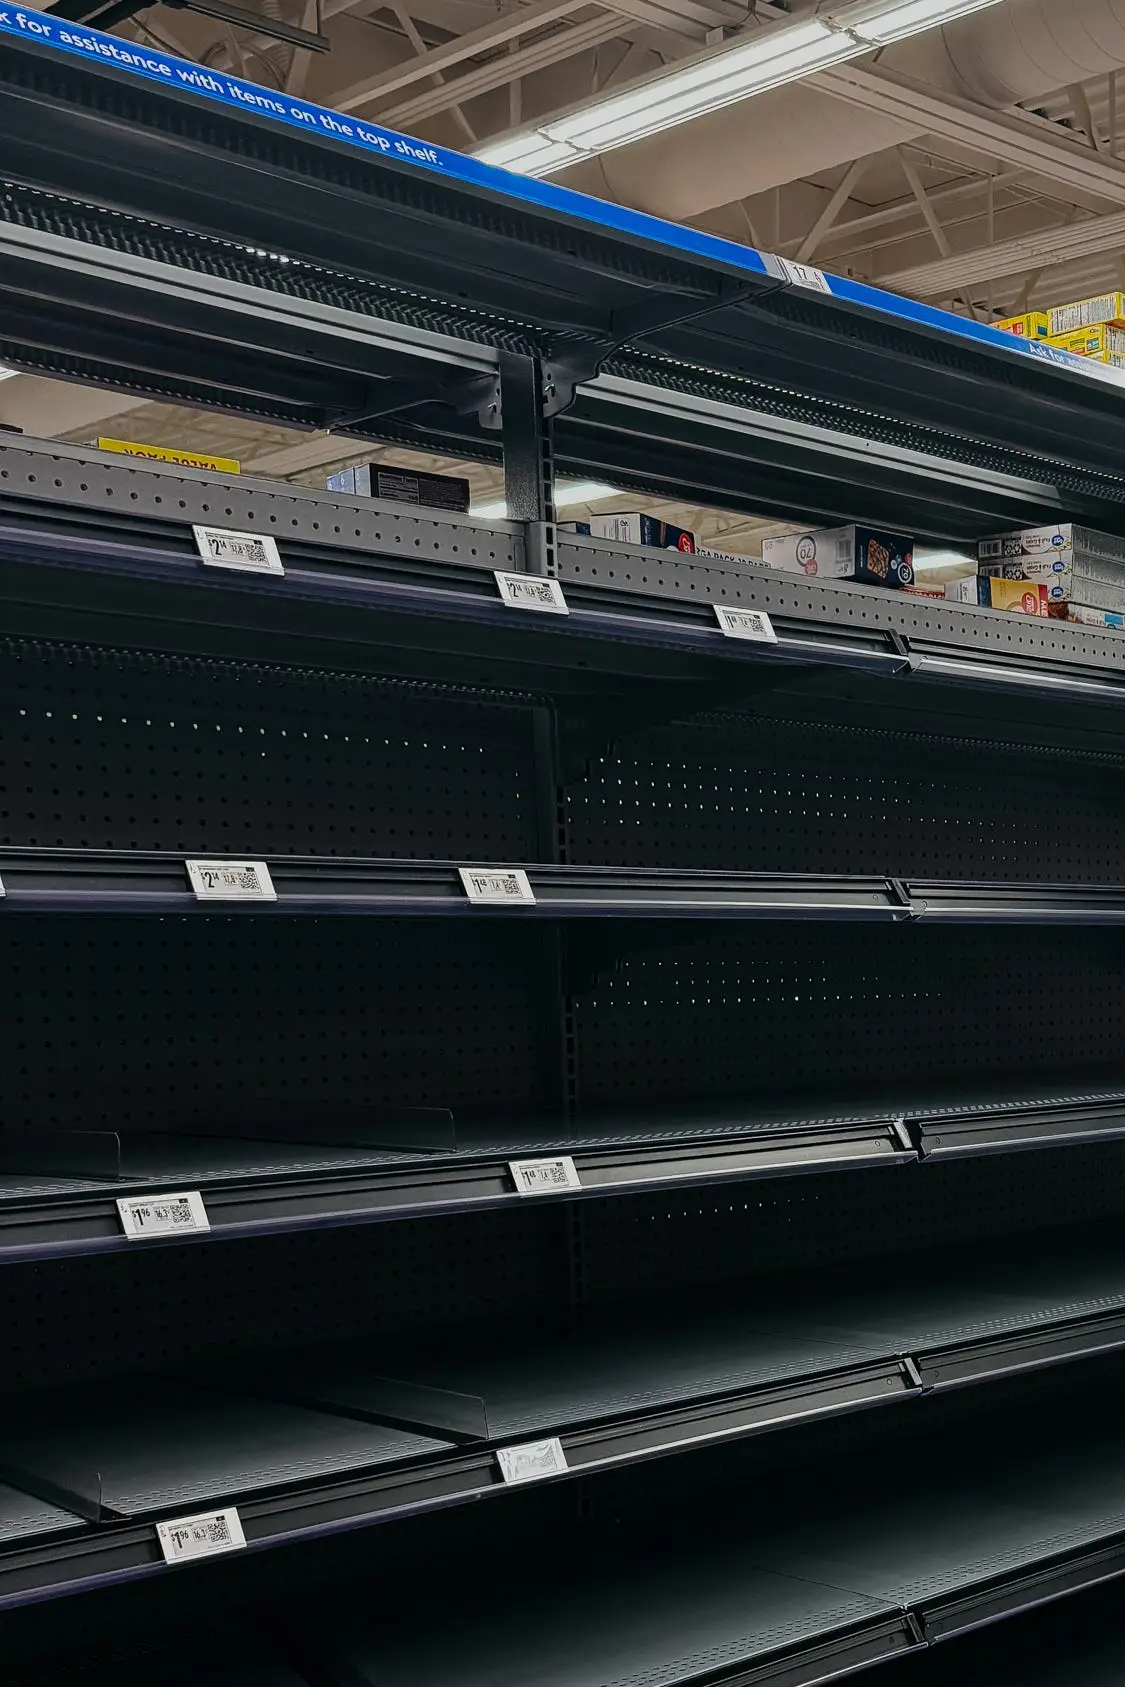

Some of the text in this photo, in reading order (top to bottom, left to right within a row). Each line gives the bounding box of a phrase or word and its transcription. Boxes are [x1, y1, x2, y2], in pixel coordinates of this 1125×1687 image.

[15, 12, 52, 37] for
[59, 28, 172, 77] assistance
[176, 68, 225, 95] with
[227, 81, 286, 115] items
[290, 108, 317, 126] on
[320, 113, 354, 138] the
[356, 127, 391, 151] top
[395, 138, 444, 167] shelf.
[1029, 342, 1049, 358] Ask
